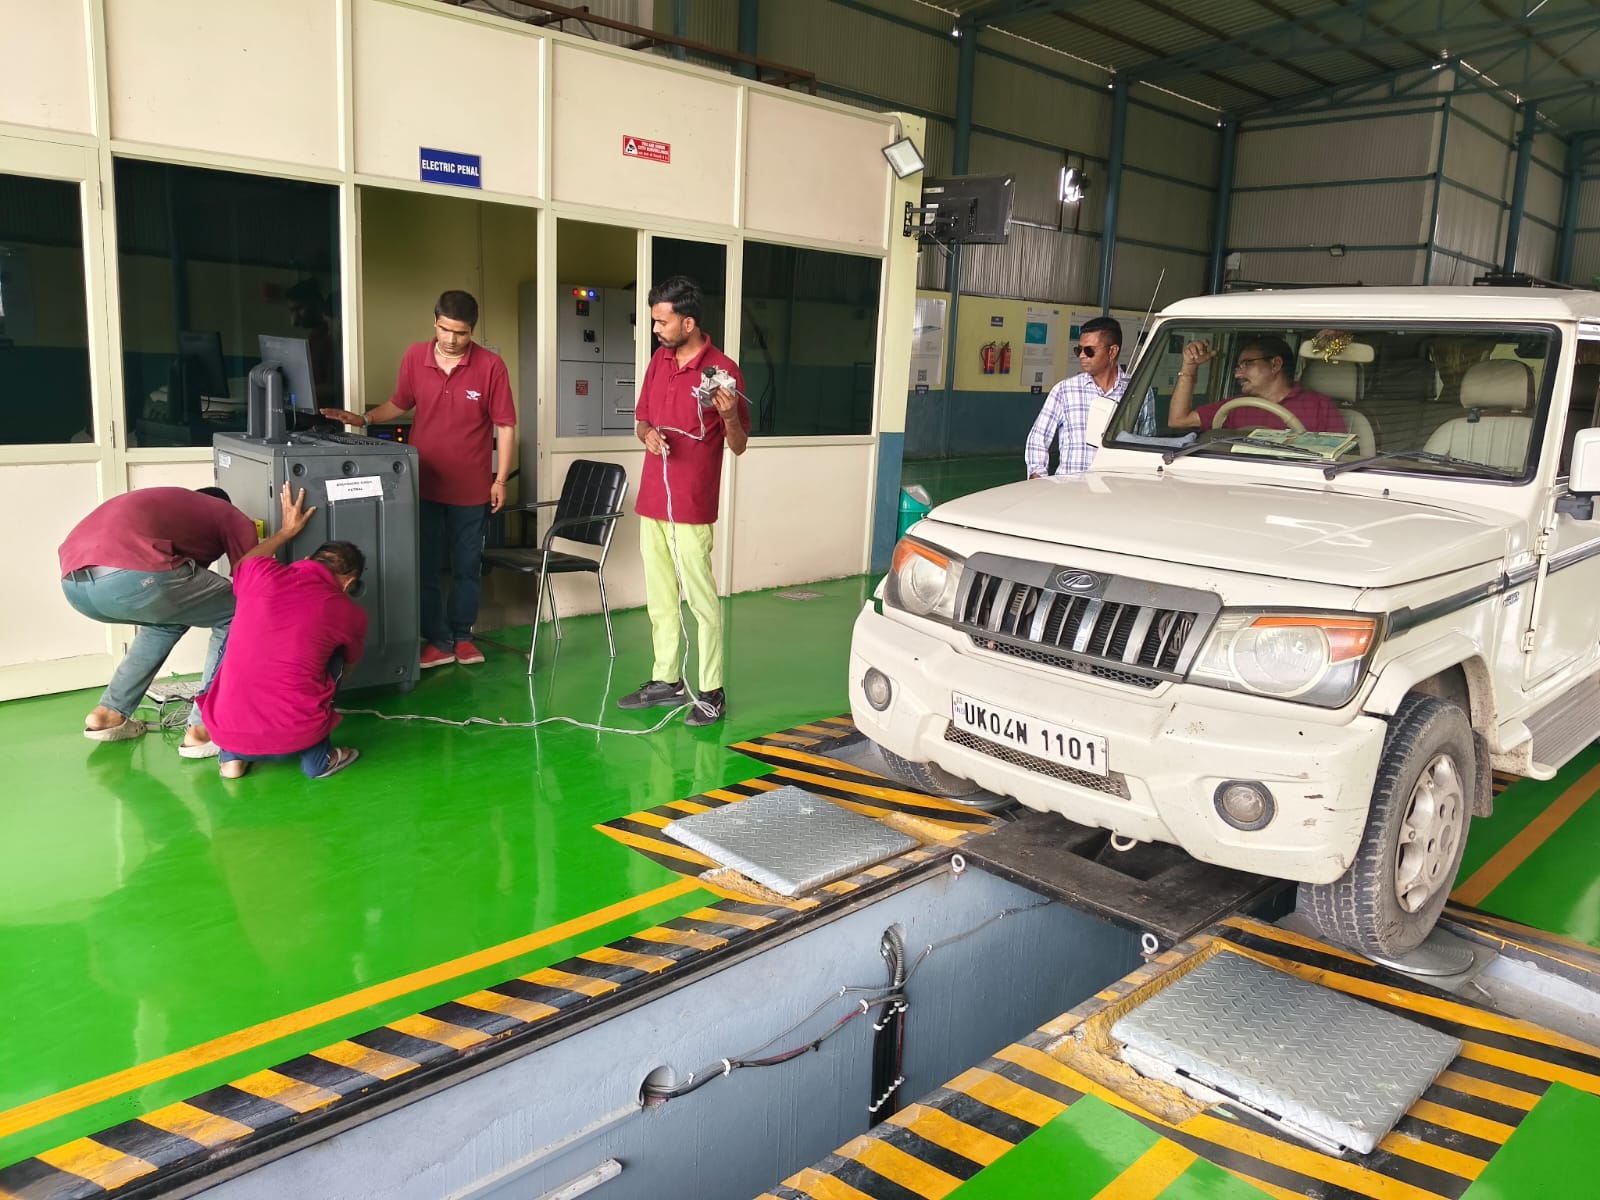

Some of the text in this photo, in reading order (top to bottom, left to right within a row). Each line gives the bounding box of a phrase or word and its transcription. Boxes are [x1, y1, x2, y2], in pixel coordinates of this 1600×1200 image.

[421, 159, 480, 177] ELECTRIC PENAL
[964, 702, 1096, 766] UK04N 1101
